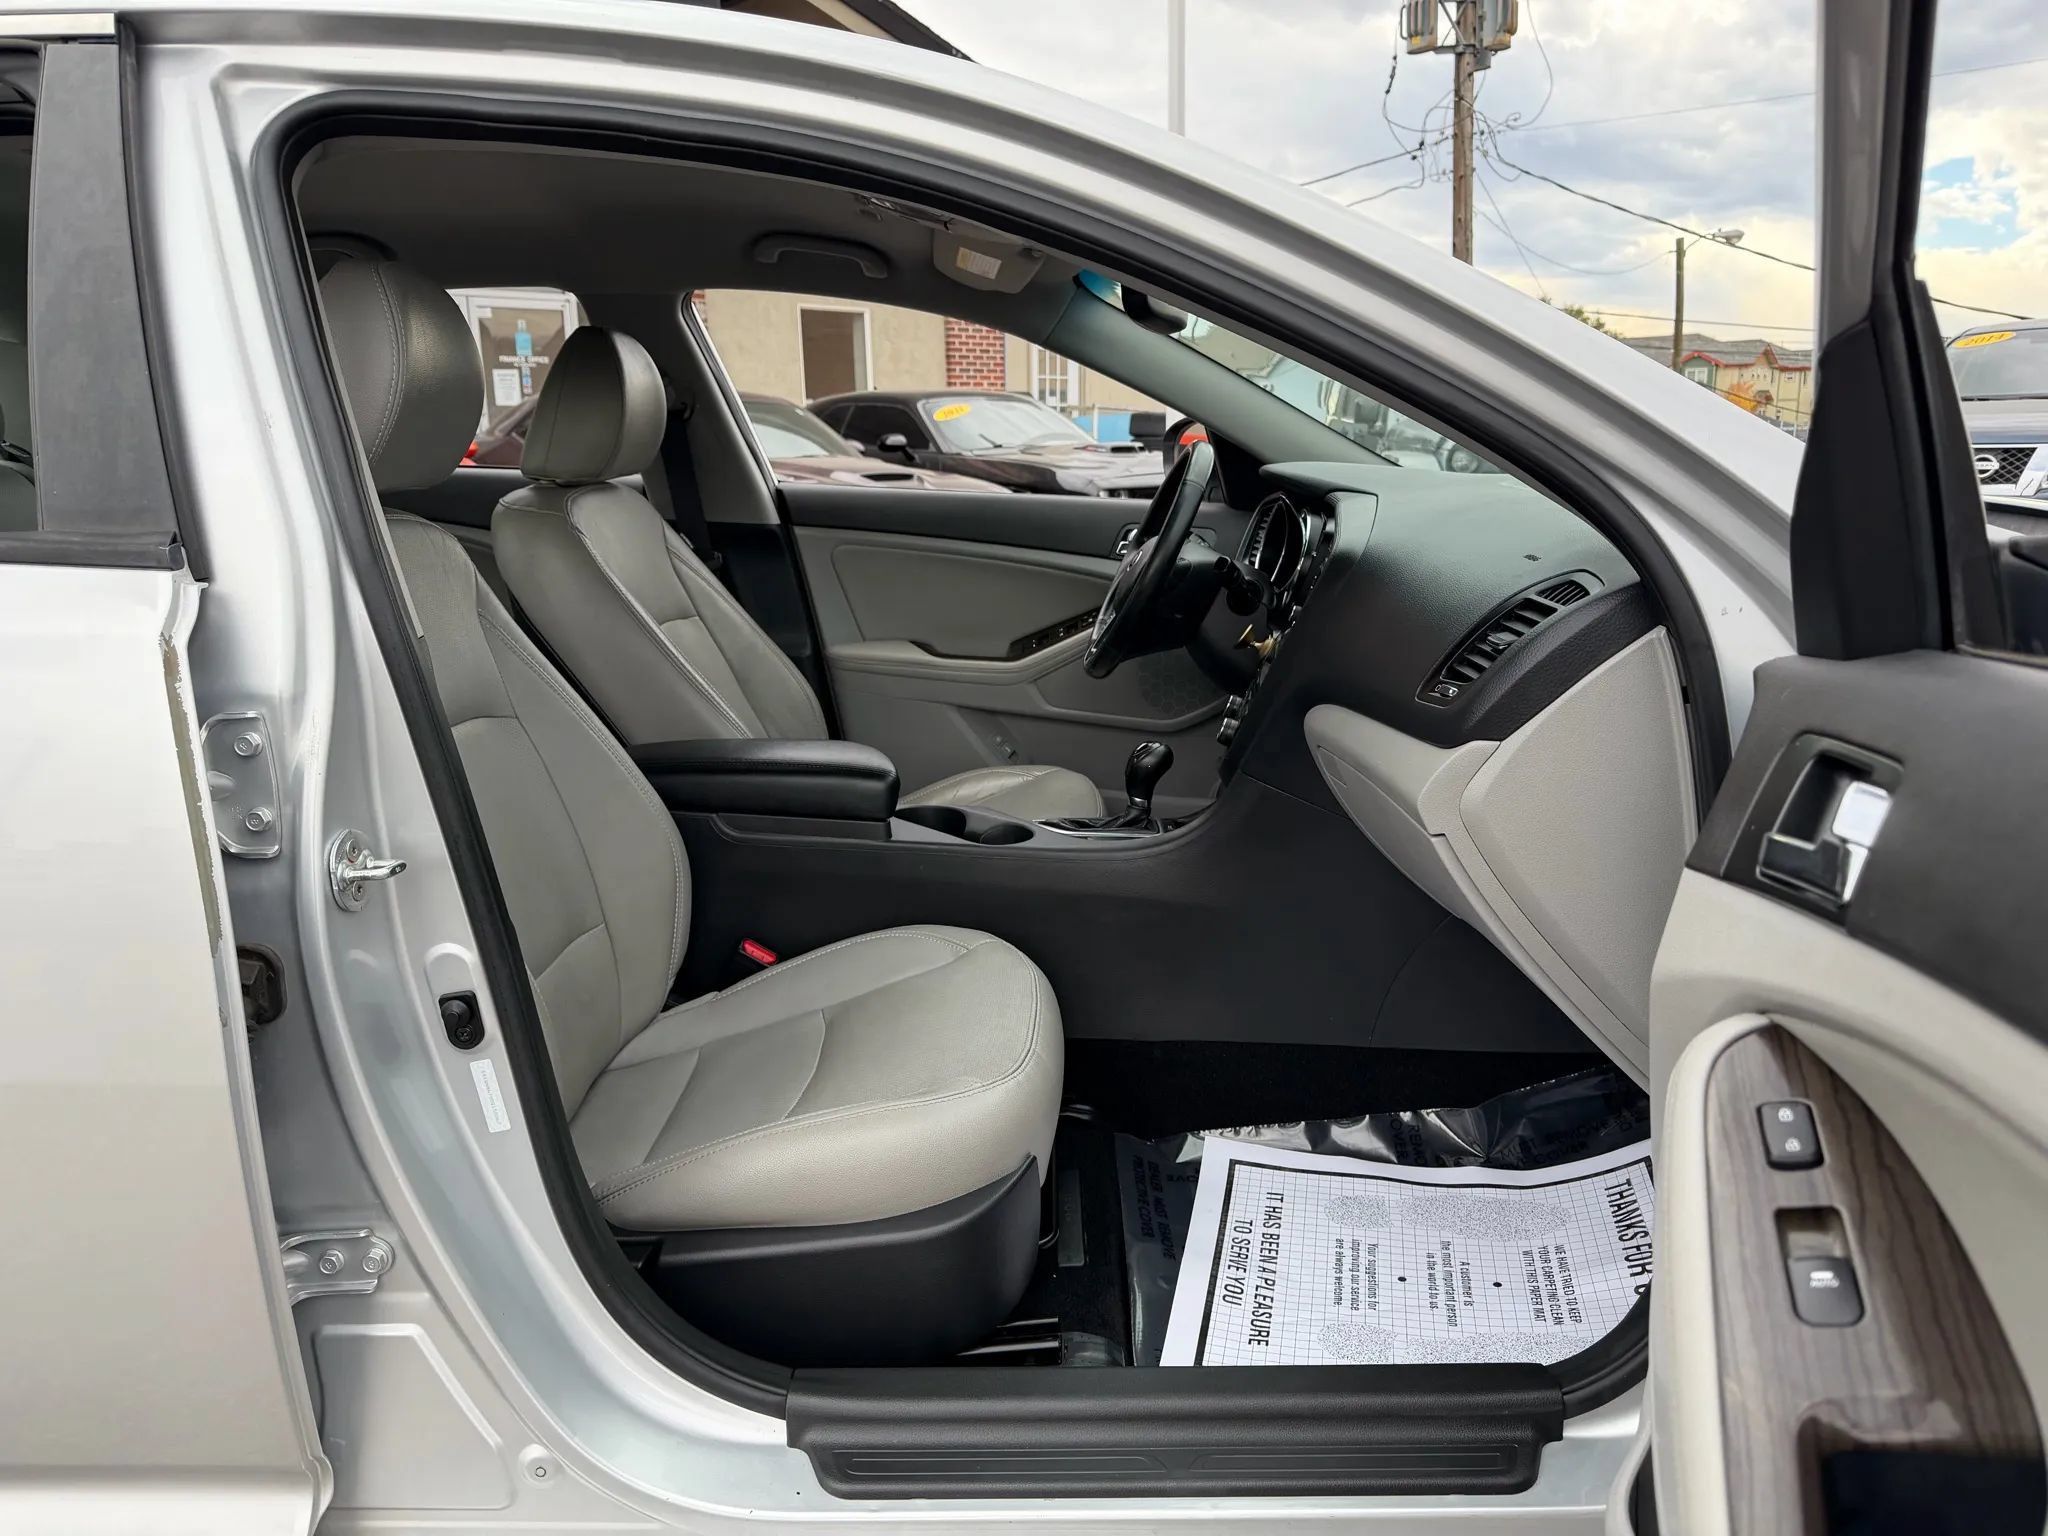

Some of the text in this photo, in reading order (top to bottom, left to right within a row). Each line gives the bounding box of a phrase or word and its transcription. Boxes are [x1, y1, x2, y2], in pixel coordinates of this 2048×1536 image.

[1335, 1238, 1344, 1249] are
[1604, 1178, 1650, 1242] THANKS
[1222, 1220, 1253, 1306] TO SERVE YOU
[1248, 1192, 1284, 1346] IT HAS BEEN A PLEASURE
[1333, 1251, 1345, 1274] always
[1349, 1239, 1362, 1311] improving our service
[1365, 1243, 1379, 1311] Your suggestions for
[1427, 1260, 1438, 1270] the
[1428, 1273, 1440, 1291] world
[1442, 1241, 1458, 1327] the most important person
[1461, 1268, 1473, 1298] customer
[1522, 1250, 1546, 1322] WITH THIS PAPER MAT
[1538, 1245, 1564, 1325] YOUR CARPETING CLEAN
[1554, 1245, 1582, 1323] WE HAVE TRIED TO KEEP
